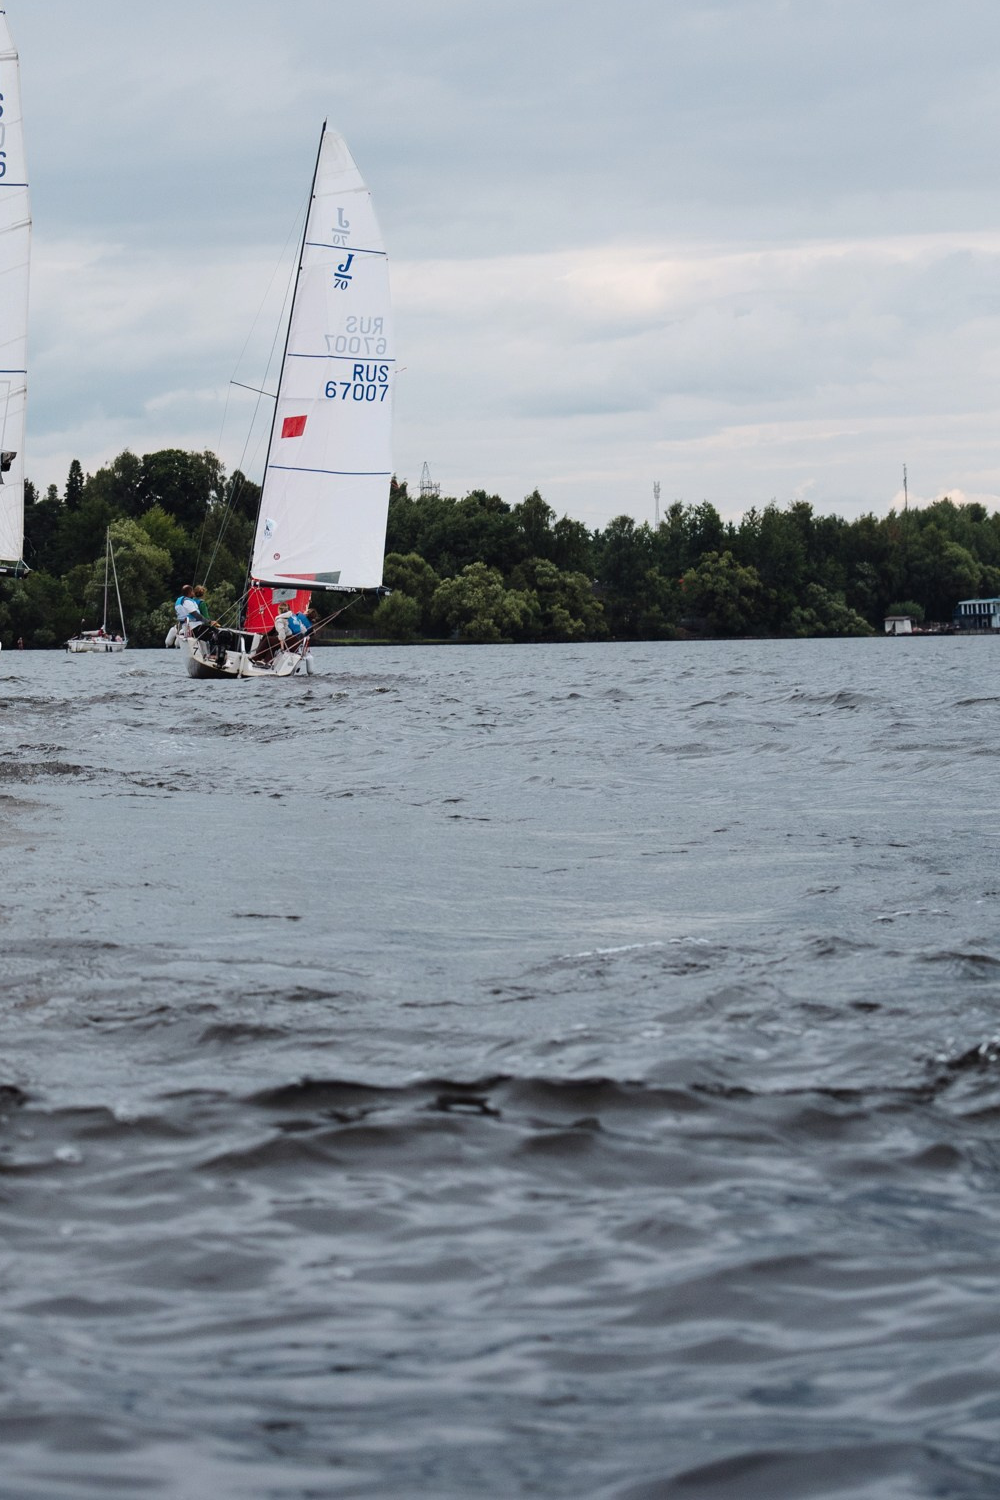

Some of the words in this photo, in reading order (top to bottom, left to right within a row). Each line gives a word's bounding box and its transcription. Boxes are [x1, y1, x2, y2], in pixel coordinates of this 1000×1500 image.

[338, 253, 355, 273] J
[333, 278, 348, 290] 70
[353, 364, 389, 382] RUS
[325, 381, 389, 401] 67007
[193, 647, 199, 655] 7
